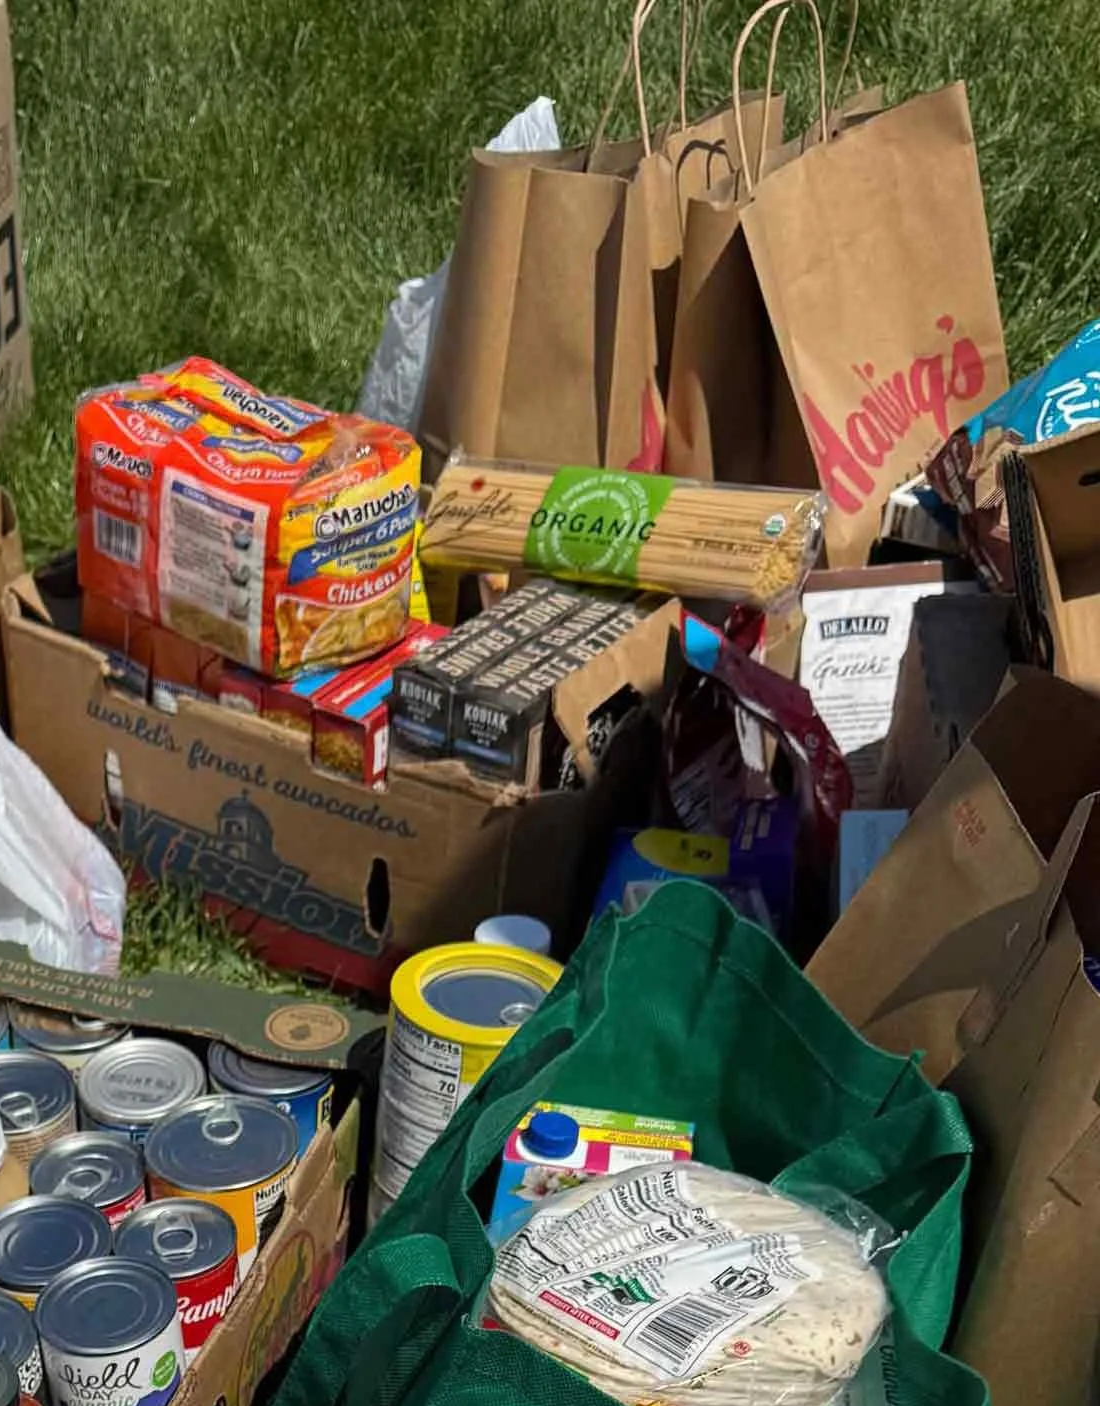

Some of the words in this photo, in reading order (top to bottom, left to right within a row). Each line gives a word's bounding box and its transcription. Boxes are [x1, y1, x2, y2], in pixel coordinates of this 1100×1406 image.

[332, 484, 414, 529] Maruchan
[530, 508, 657, 542] ORGANIC
[327, 571, 396, 604] Chicken
[507, 592, 583, 637] WHOLE
[436, 629, 516, 676] GRAINS
[473, 644, 551, 689] WHOLE
[541, 600, 619, 648] GRAINS
[505, 656, 579, 700] TASTE
[570, 610, 640, 662] BETTER
[399, 679, 444, 711] KODIAK
[463, 702, 511, 734] KODIAK
[86, 701, 183, 753] world's
[187, 740, 267, 790] finest
[437, 1079, 456, 1095] 70
[57, 1357, 144, 1391] field
